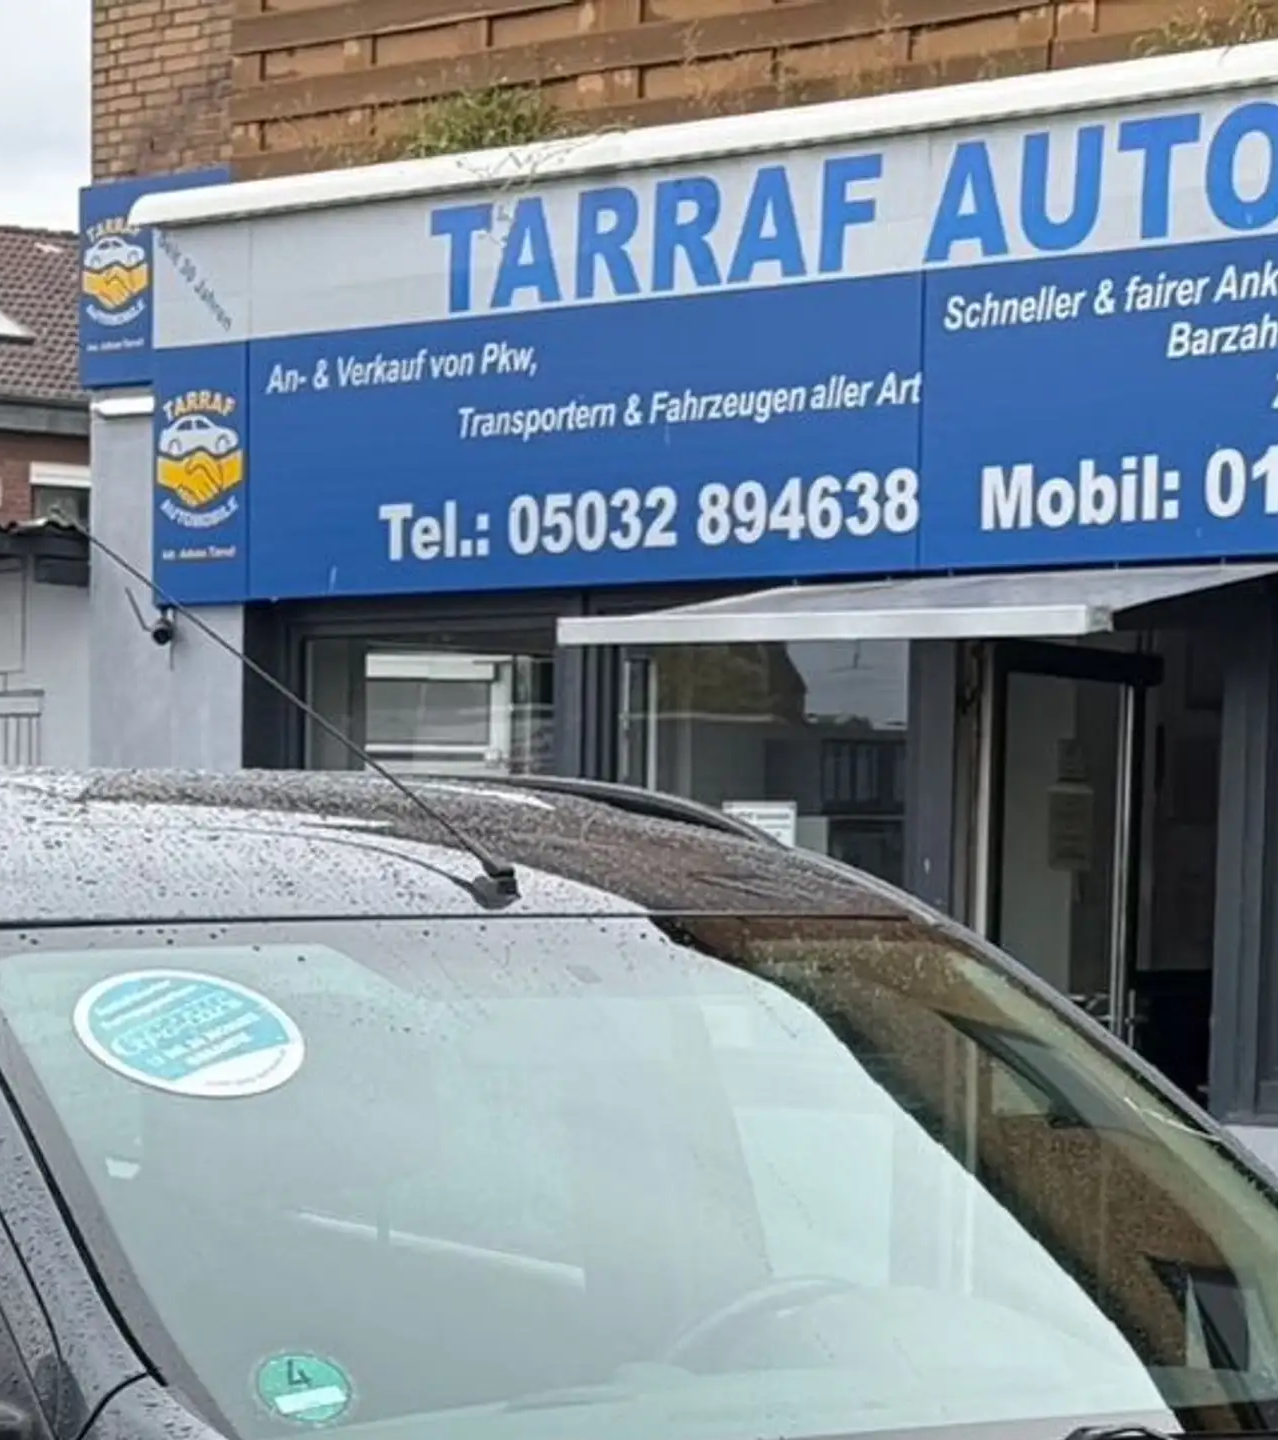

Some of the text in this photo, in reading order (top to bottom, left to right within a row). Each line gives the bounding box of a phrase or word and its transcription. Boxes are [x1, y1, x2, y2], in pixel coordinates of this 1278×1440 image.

[429, 152, 885, 312] TARRAF
[943, 285, 1086, 331] Schneller
[1093, 279, 1115, 315] &
[1124, 274, 1210, 312] fairer
[266, 341, 539, 395] An- & Verkauf von Pkw,
[162, 389, 235, 421] TARRAF
[458, 371, 922, 442] Transportern & Fahrzeugen aller Art
[379, 467, 920, 561] Tel.: 05032 894638
[979, 454, 1181, 532] Mobil:
